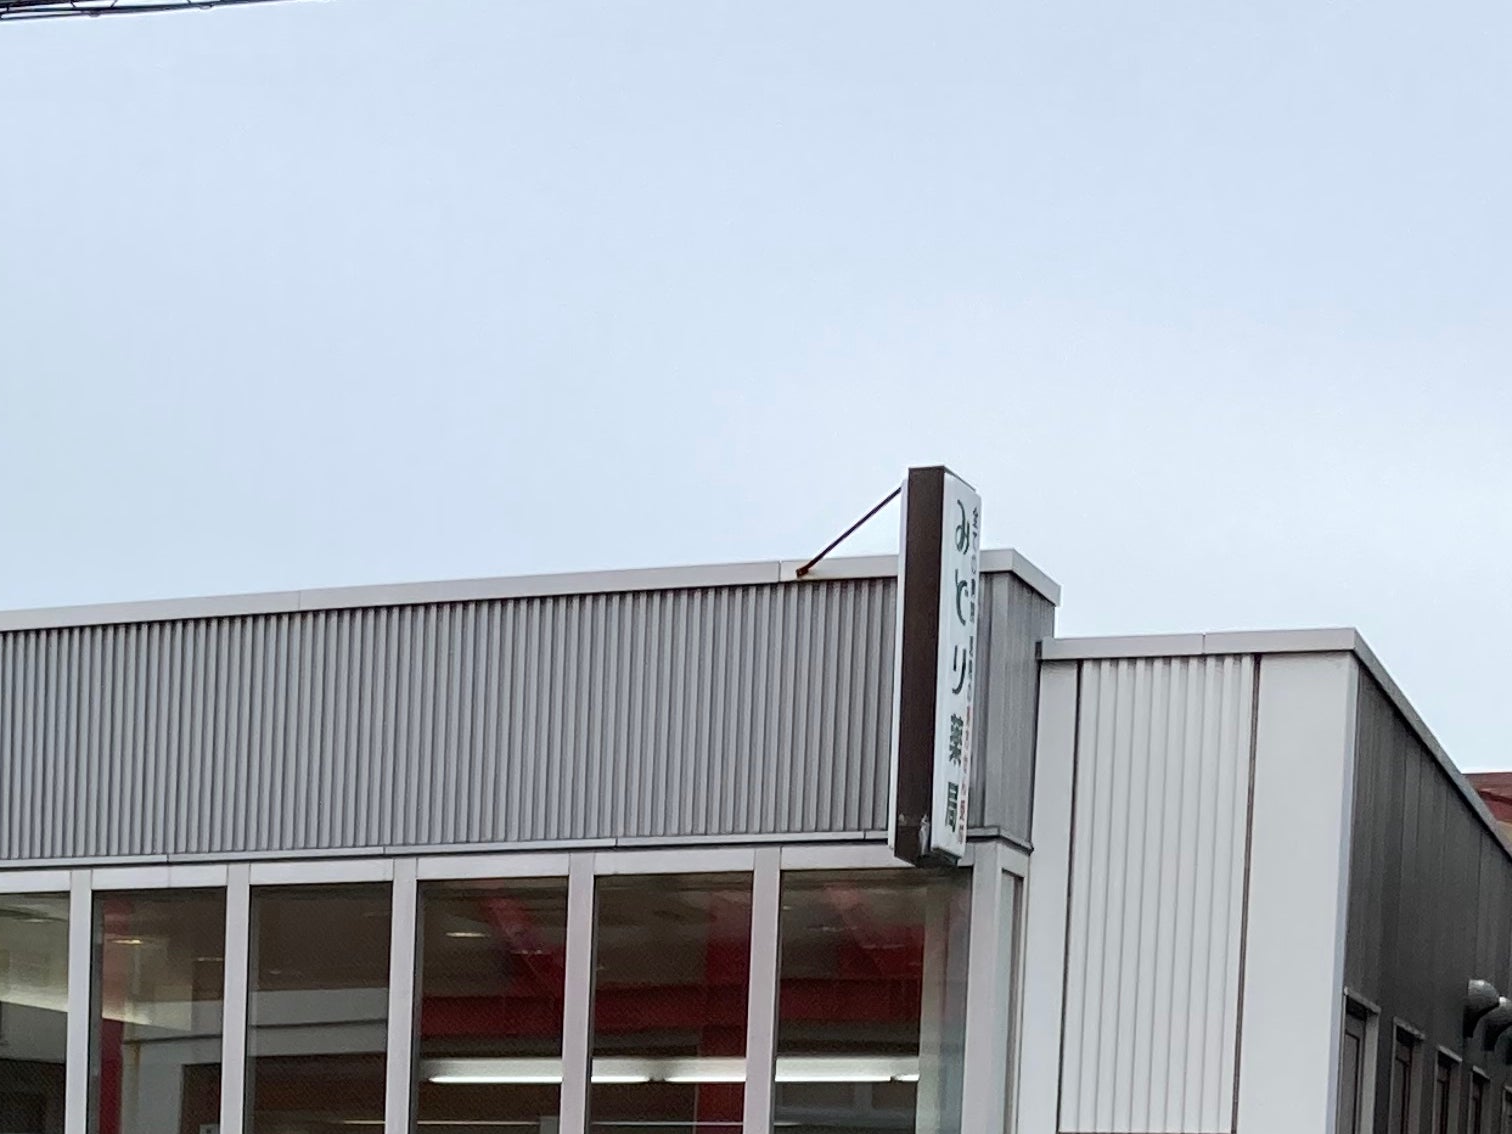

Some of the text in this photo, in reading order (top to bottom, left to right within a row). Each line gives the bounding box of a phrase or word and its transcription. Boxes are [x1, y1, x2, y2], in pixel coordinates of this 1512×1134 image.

[945, 499, 970, 833] みどり薬局
